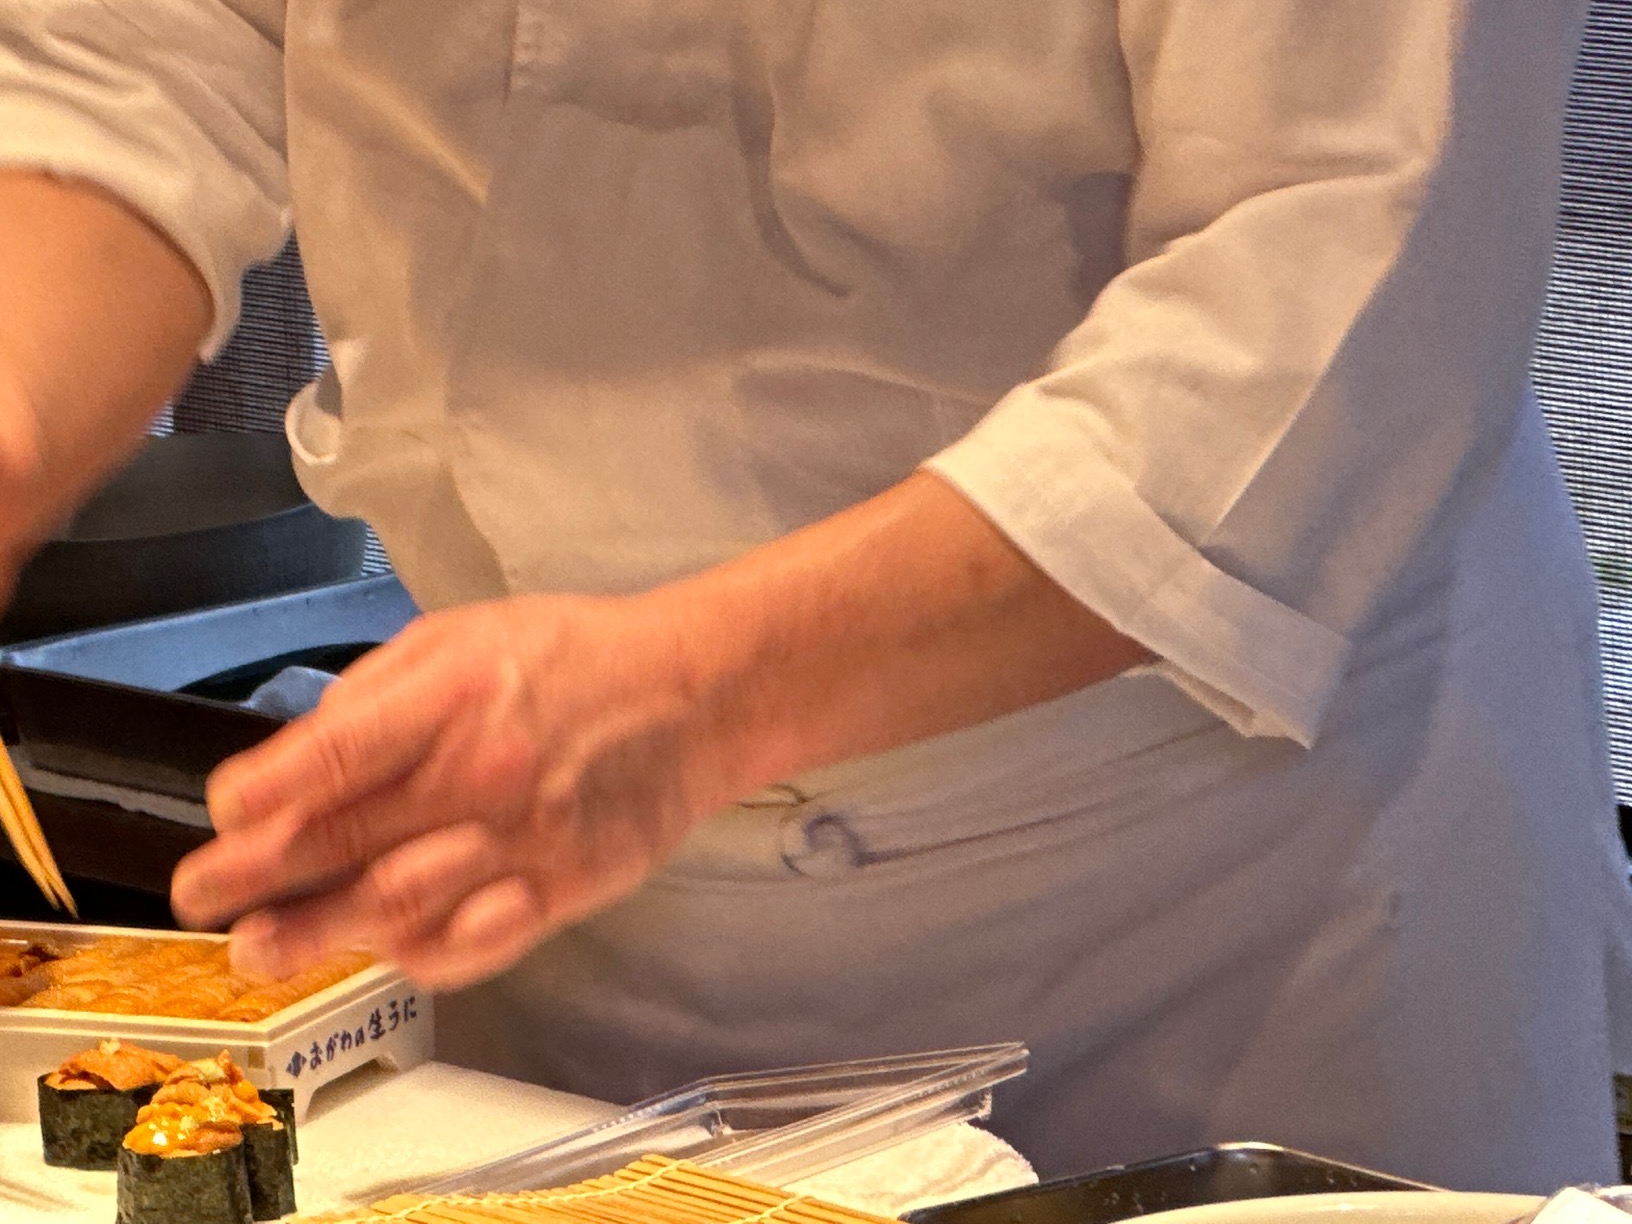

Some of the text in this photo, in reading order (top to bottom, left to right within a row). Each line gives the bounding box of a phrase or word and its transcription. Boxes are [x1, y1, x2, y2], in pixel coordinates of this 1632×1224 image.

[309, 995, 417, 1070] おがわの生うに
